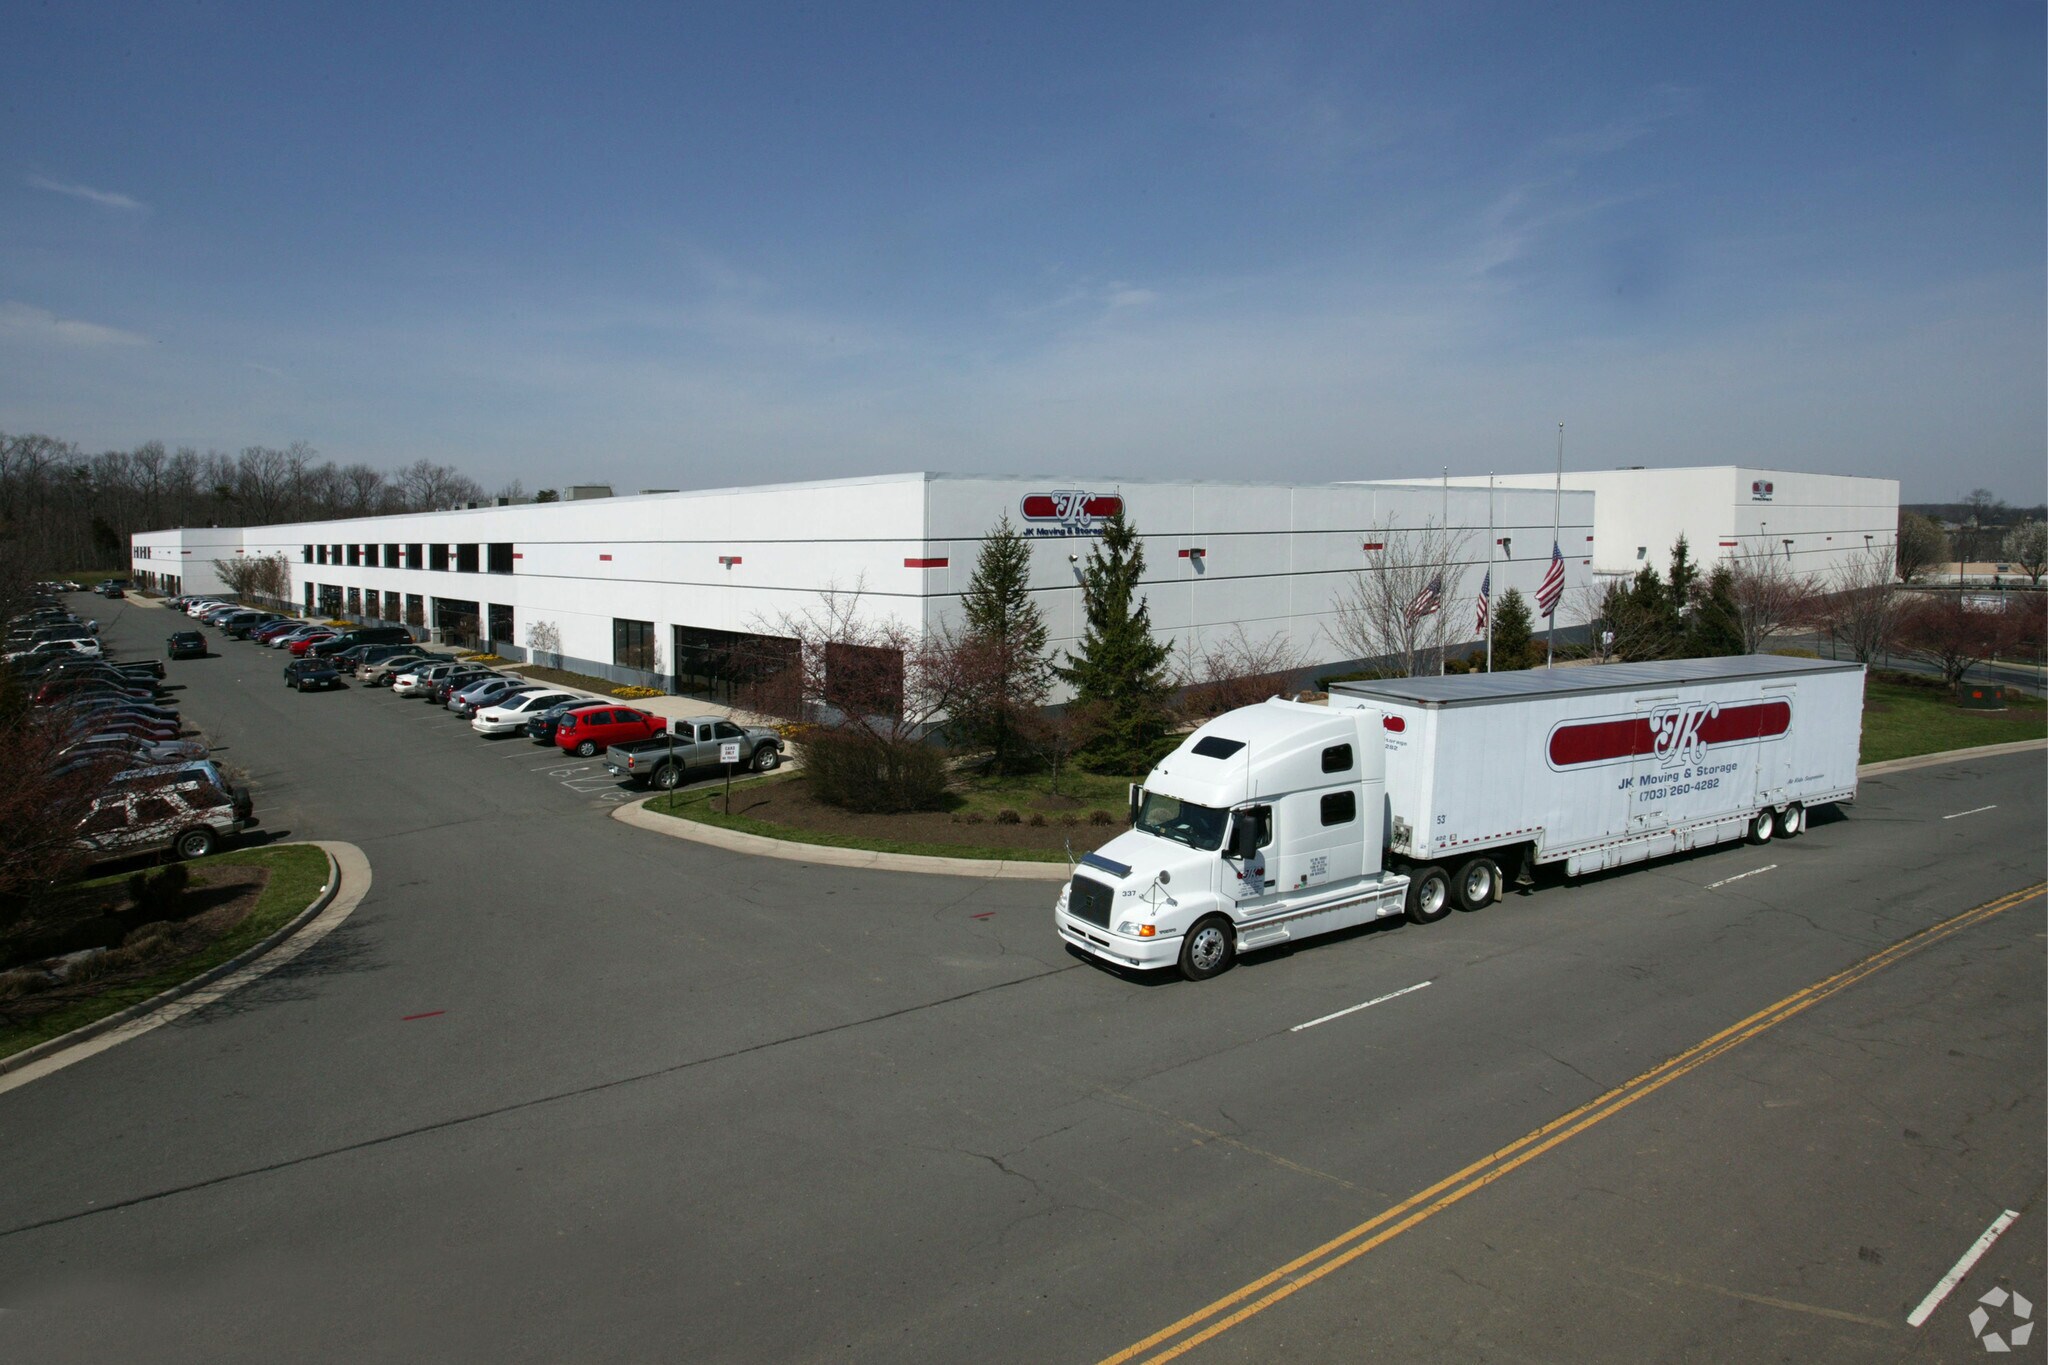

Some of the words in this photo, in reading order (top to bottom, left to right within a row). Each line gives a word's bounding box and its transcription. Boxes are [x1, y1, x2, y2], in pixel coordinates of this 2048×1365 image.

[1051, 490, 1096, 525] JK
[1023, 528, 1034, 536] JK
[1036, 527, 1065, 536] Moving
[1066, 527, 1073, 535] &
[1074, 527, 1104, 536] Storag
[1649, 700, 1719, 769] JK
[1618, 777, 1634, 789] JK
[1639, 771, 1679, 787] Moving
[1684, 768, 1692, 778] &
[1696, 762, 1738, 776] Storage
[1639, 788, 1667, 802] (703)
[1669, 778, 1720, 796] 260-4282
